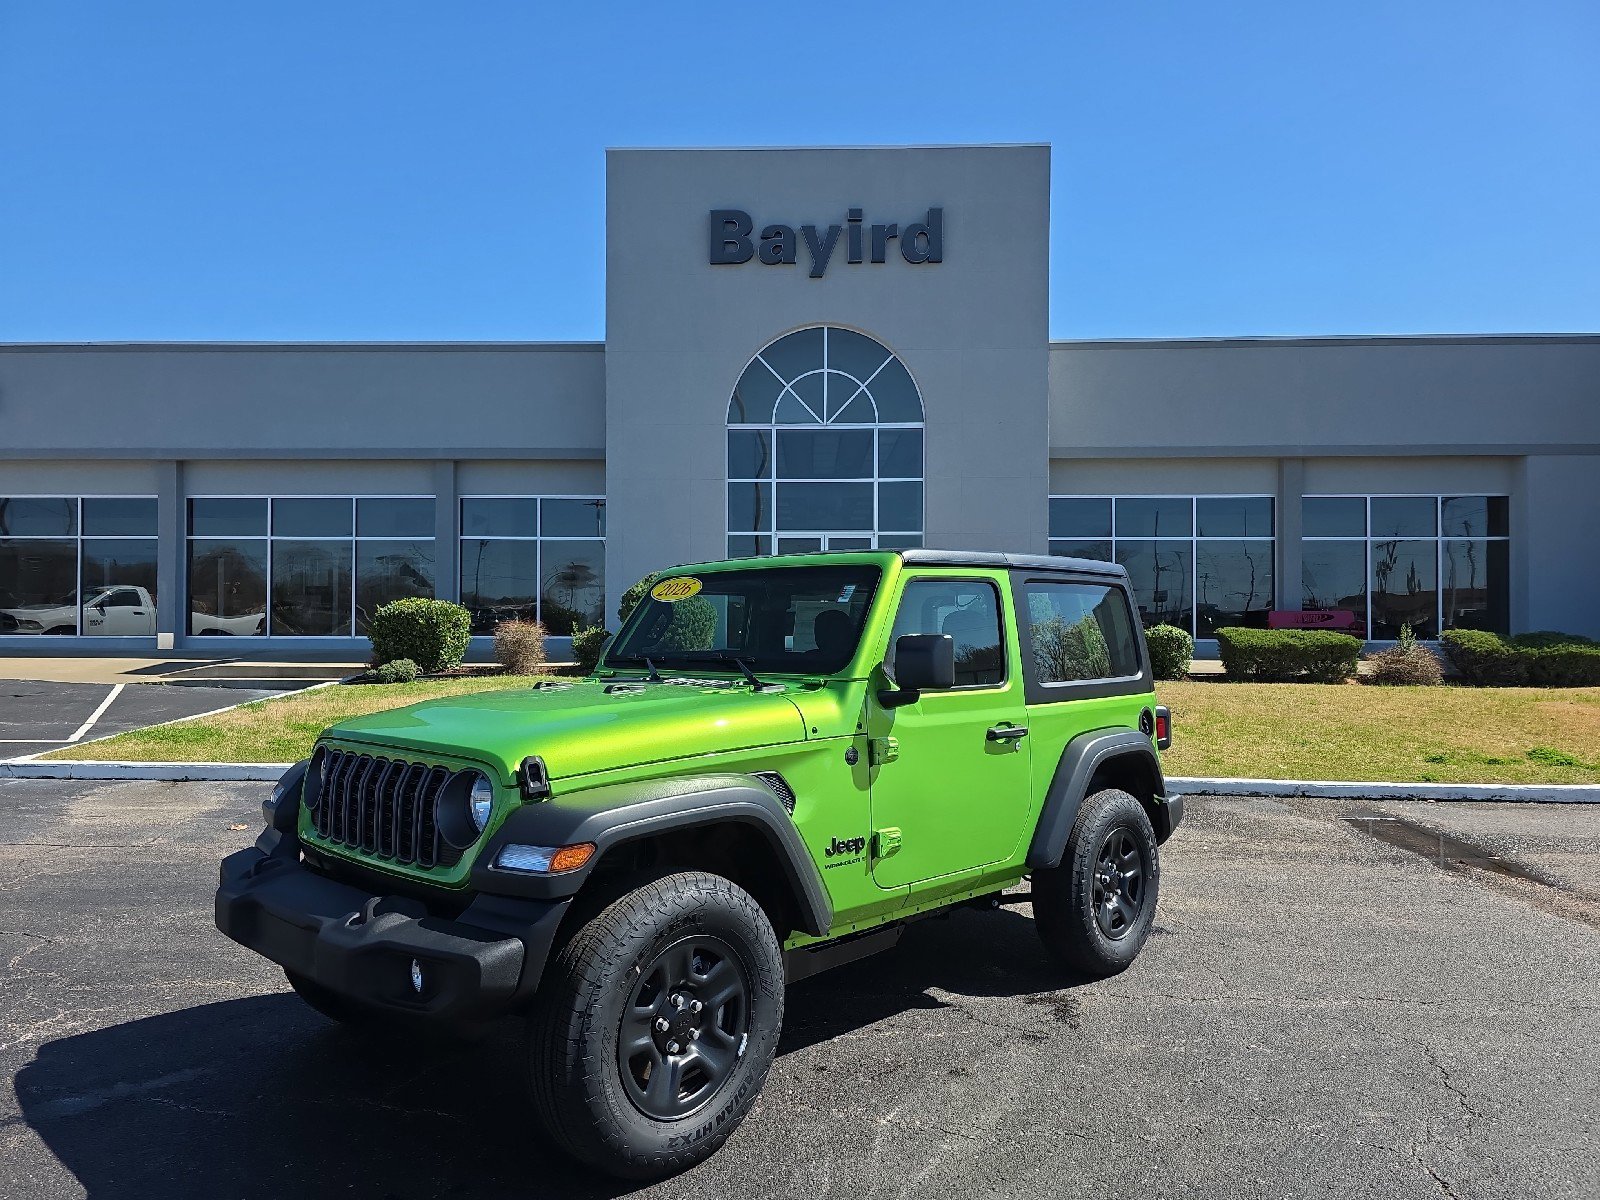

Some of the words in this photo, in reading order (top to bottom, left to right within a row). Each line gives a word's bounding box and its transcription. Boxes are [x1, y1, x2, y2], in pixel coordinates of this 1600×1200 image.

[710, 208, 943, 278] Bayird
[825, 836, 865, 856] Jeep
[825, 858, 860, 869] WRANGLER
[667, 1121, 713, 1148] HTX2
